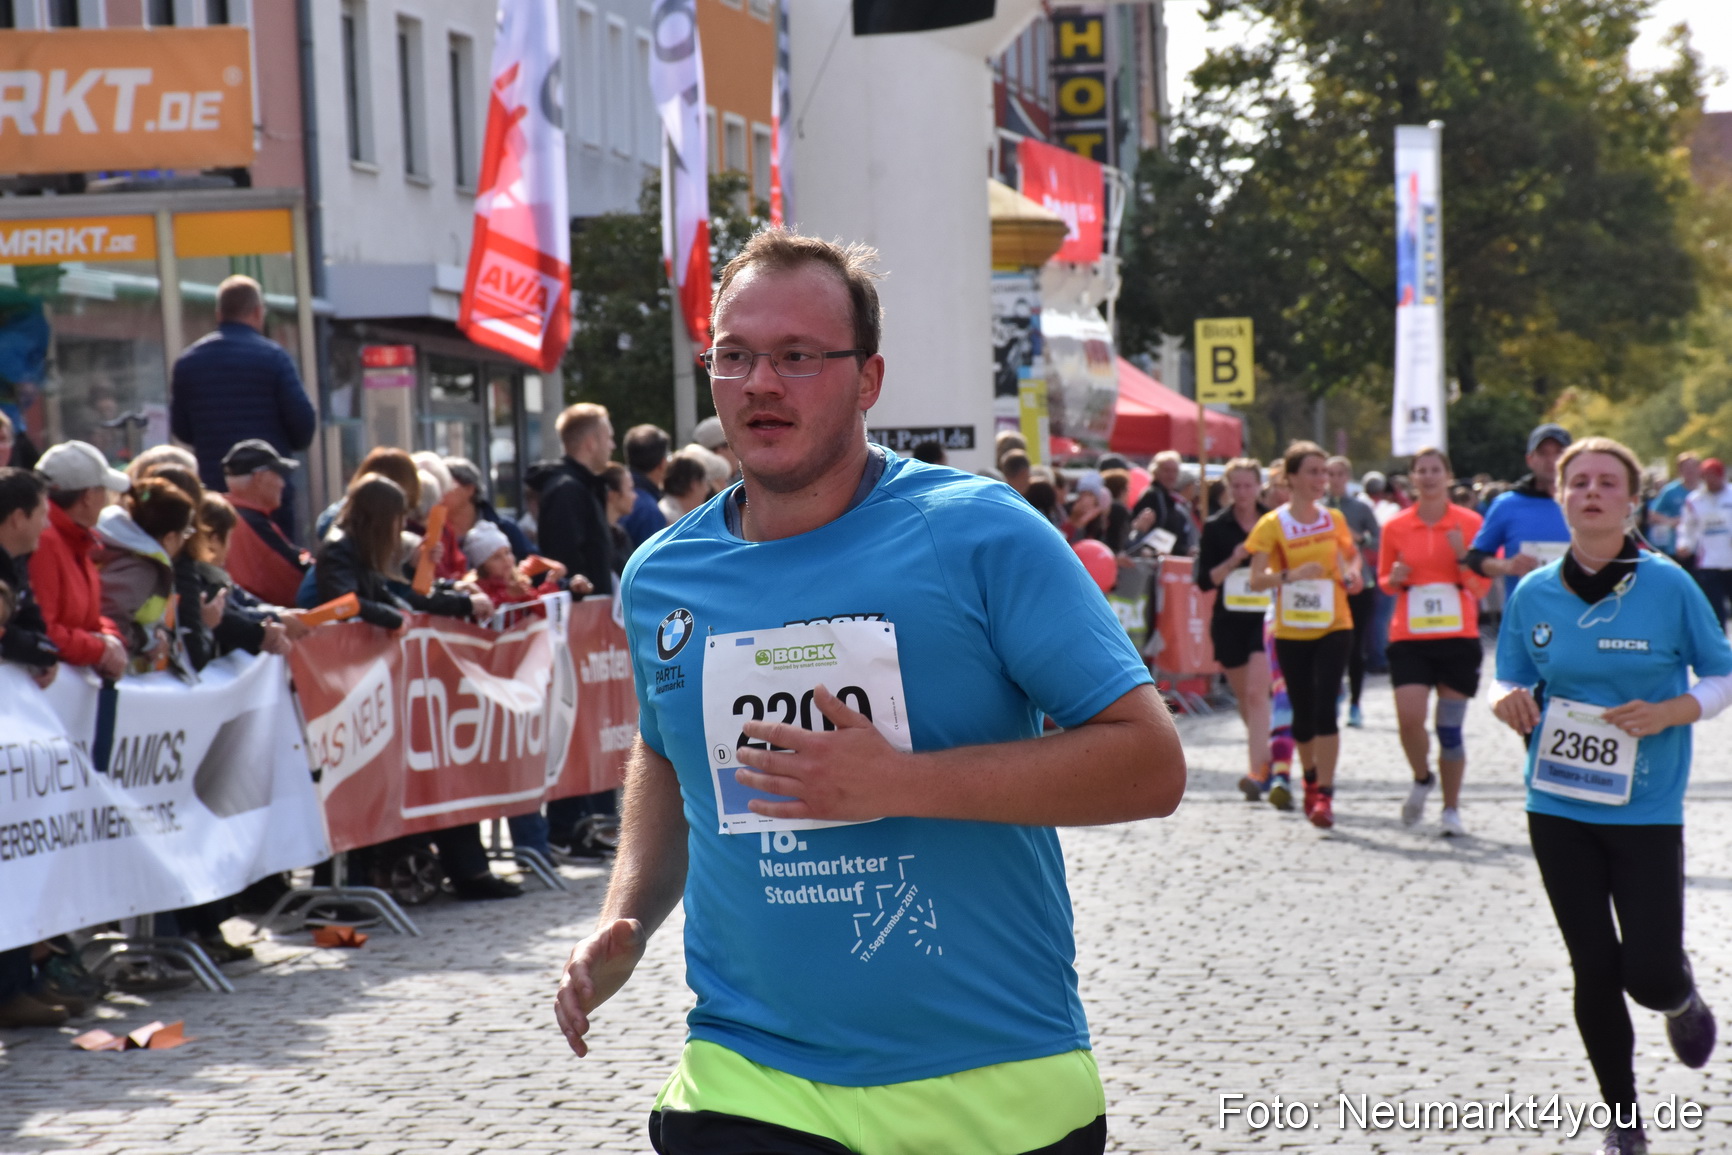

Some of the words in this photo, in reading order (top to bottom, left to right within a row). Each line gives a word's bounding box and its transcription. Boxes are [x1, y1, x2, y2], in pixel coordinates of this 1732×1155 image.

[1212, 345, 1239, 385] B
[1424, 599, 1443, 614] 91
[773, 643, 836, 664] BOCK
[1597, 639, 1650, 650] BOCK
[655, 665, 686, 685] PARTL
[718, 749, 726, 760] D
[1551, 728, 1620, 767] 2368
[1548, 764, 1614, 787] Tamara-Lilian
[759, 855, 889, 878] Neumarkter
[764, 881, 865, 906] Stadtlauf
[860, 950, 875, 963] 17.
[868, 905, 906, 952] September
[901, 884, 919, 908] 2017
